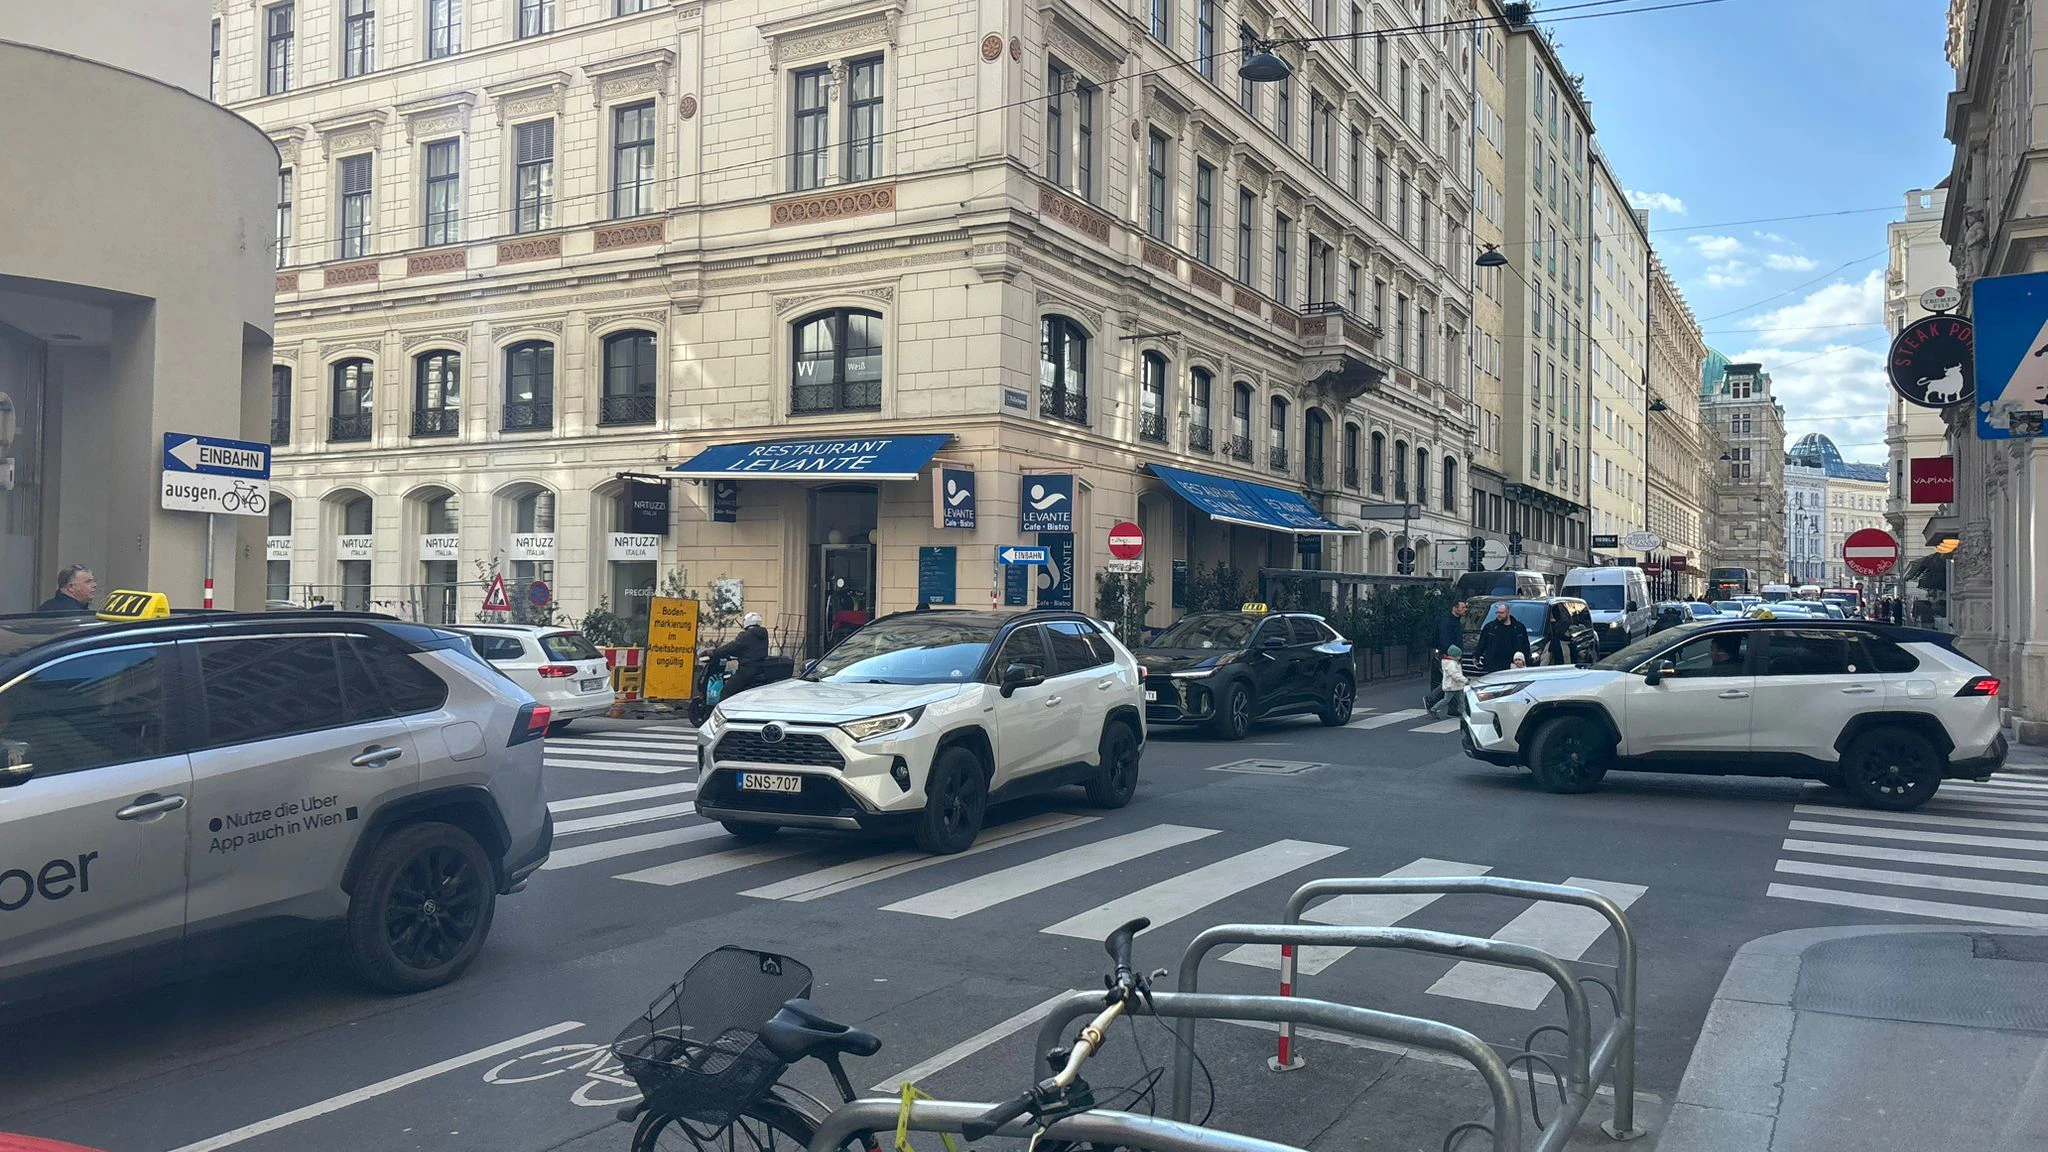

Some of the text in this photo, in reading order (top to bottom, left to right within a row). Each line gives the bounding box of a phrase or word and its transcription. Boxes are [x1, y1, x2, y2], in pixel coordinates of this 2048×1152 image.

[1895, 322, 1973, 366] STEAK POI
[848, 362, 866, 371] Weiß
[748, 440, 892, 457] RESTAURANT
[200, 447, 260, 469] EINBAHN
[726, 455, 878, 472] LEVANTE
[1913, 476, 1954, 485] VAPIAN
[166, 484, 221, 502] ausgen.
[634, 500, 666, 510] NATUZZI
[944, 508, 974, 518] LEVANTE
[1023, 512, 1070, 522] LEVANTE
[945, 518, 974, 528] Cafe Bistro
[1024, 523, 1070, 531] Cafe Bistro
[267, 539, 291, 549] NATUZ
[342, 538, 372, 548] NATUZZ
[425, 538, 458, 548] NATUZZ
[516, 537, 554, 548] NATUZZ
[1014, 550, 1042, 560] EINBAHN
[1062, 540, 1072, 598] LEVANTE
[624, 588, 654, 597] PRECIO
[102, 594, 147, 614] TAXI
[662, 606, 686, 616] Boden-
[654, 618, 692, 632] markierung
[668, 631, 676, 641] im
[648, 642, 695, 655] Arbeitsbereich
[656, 656, 684, 668] ungültig
[745, 775, 799, 790] SNS-707
[226, 794, 338, 830] Nutze die Uber
[208, 811, 342, 854] App auch in Wien
[0, 851, 98, 912] ber
